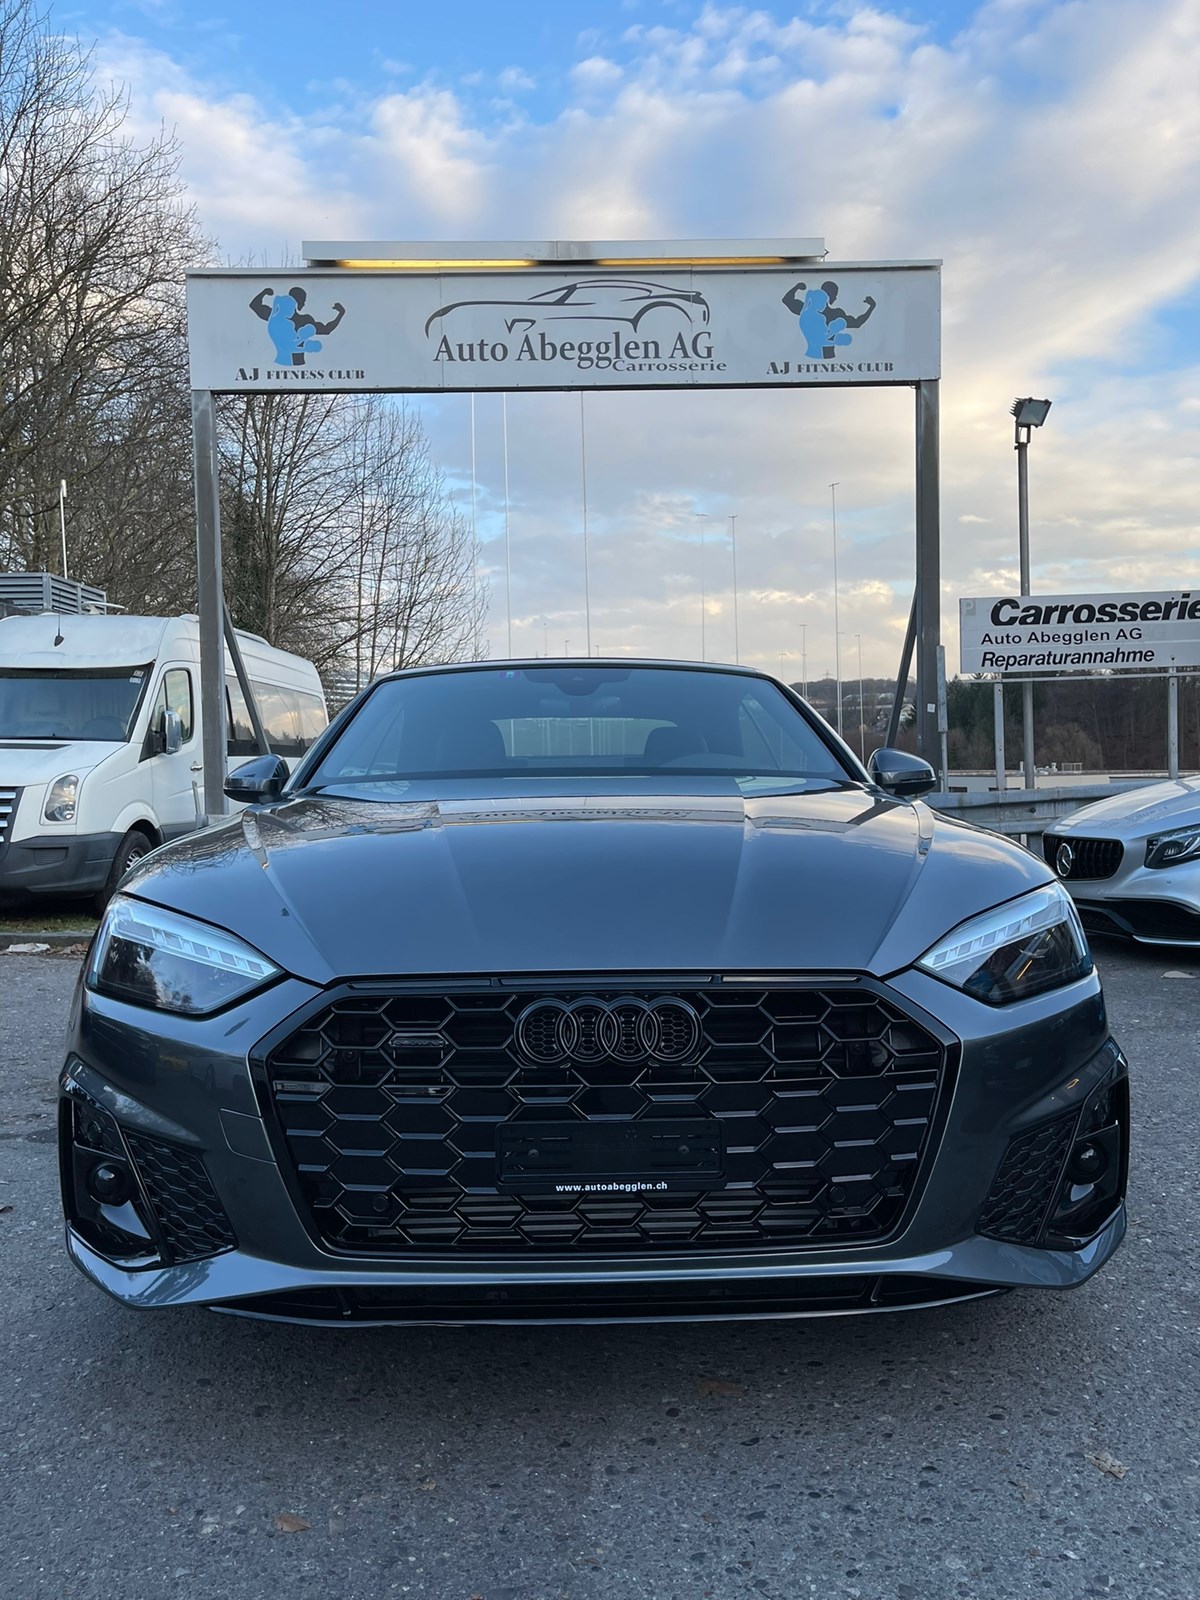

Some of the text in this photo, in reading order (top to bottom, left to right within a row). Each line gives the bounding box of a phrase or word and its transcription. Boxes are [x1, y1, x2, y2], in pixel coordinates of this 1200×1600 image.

[432, 330, 714, 370] Auto Abegglen AG
[612, 358, 727, 372] Carrosserie
[766, 361, 894, 375] AJ FITNESS CLUB
[235, 368, 365, 381] AJ FITNESS CLUB
[990, 592, 1200, 627] Carrosserie
[981, 627, 1143, 646] Auto Abegglen AG
[981, 647, 1155, 671] Reparaturannahme
[555, 1181, 668, 1192] www.autoabegglen.ch
